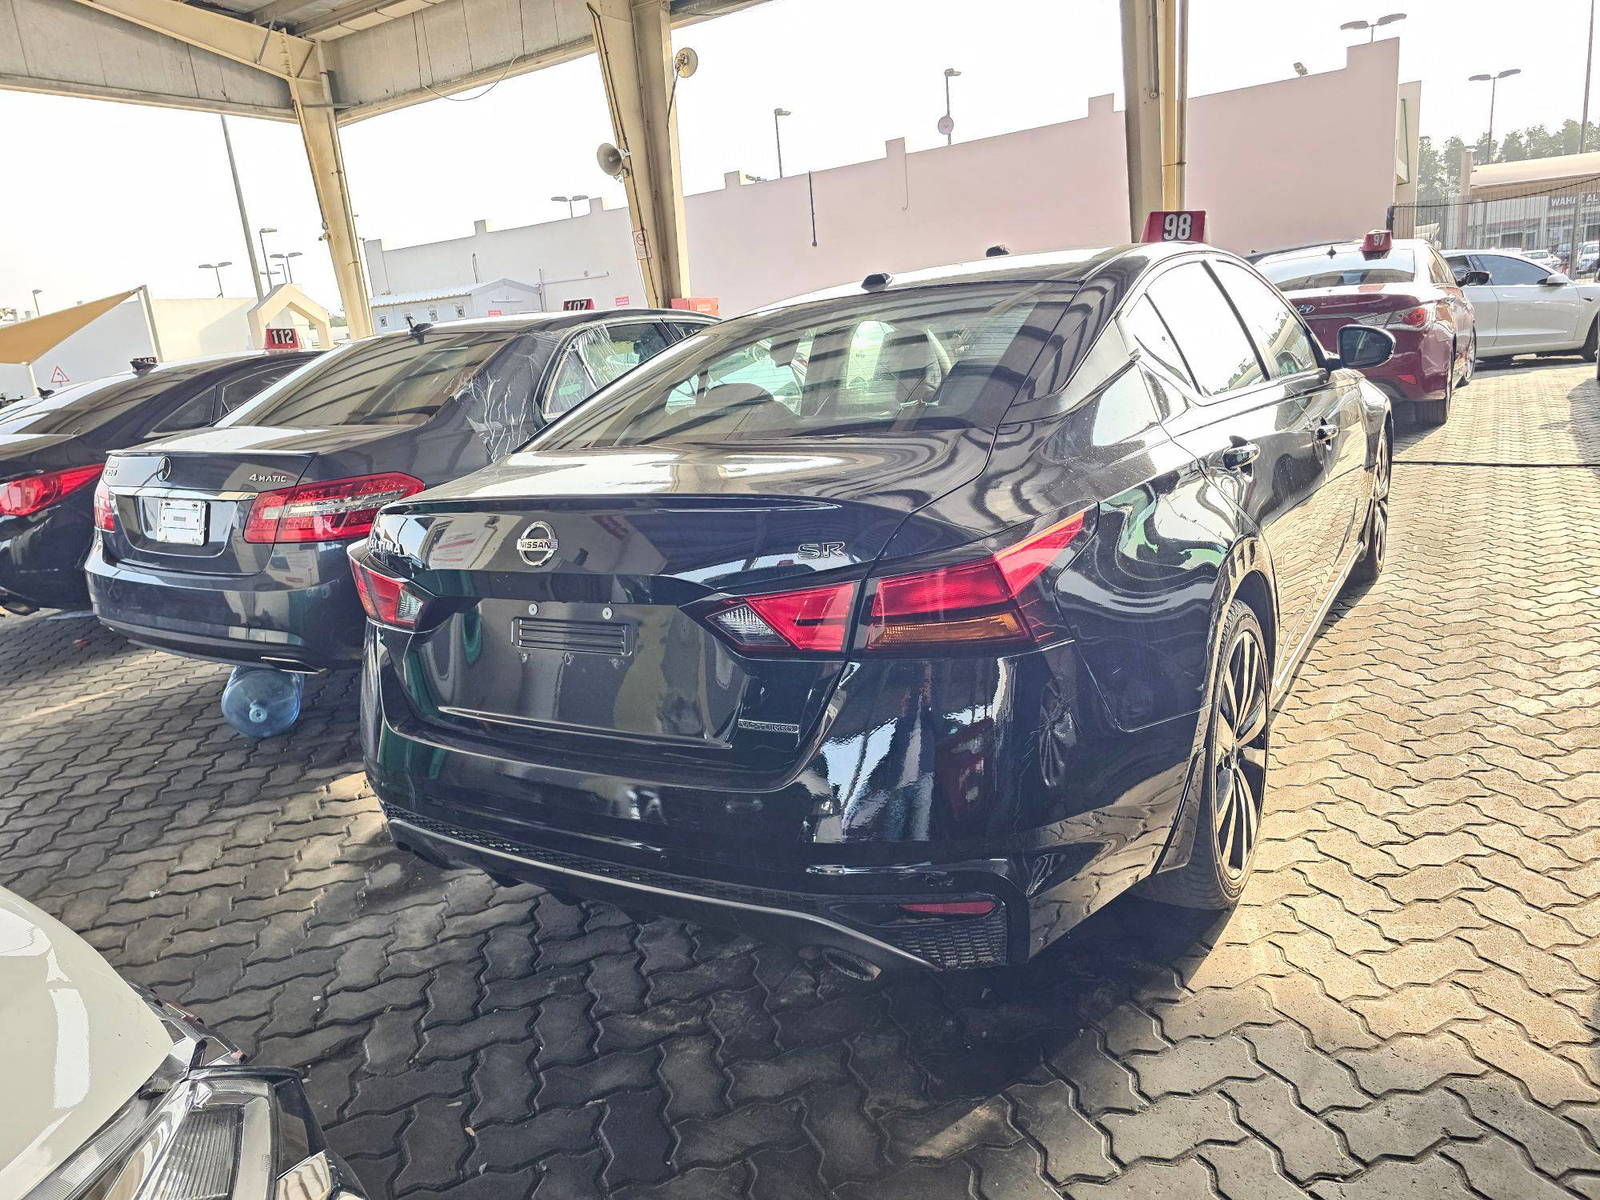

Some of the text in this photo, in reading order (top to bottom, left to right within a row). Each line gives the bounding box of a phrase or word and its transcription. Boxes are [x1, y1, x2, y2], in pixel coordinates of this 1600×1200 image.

[1163, 213, 1192, 241] 98
[1373, 234, 1385, 247] 97
[568, 300, 588, 311] 107
[271, 329, 294, 345] 112
[520, 541, 551, 549] NISSAN
[798, 541, 848, 559] SR
